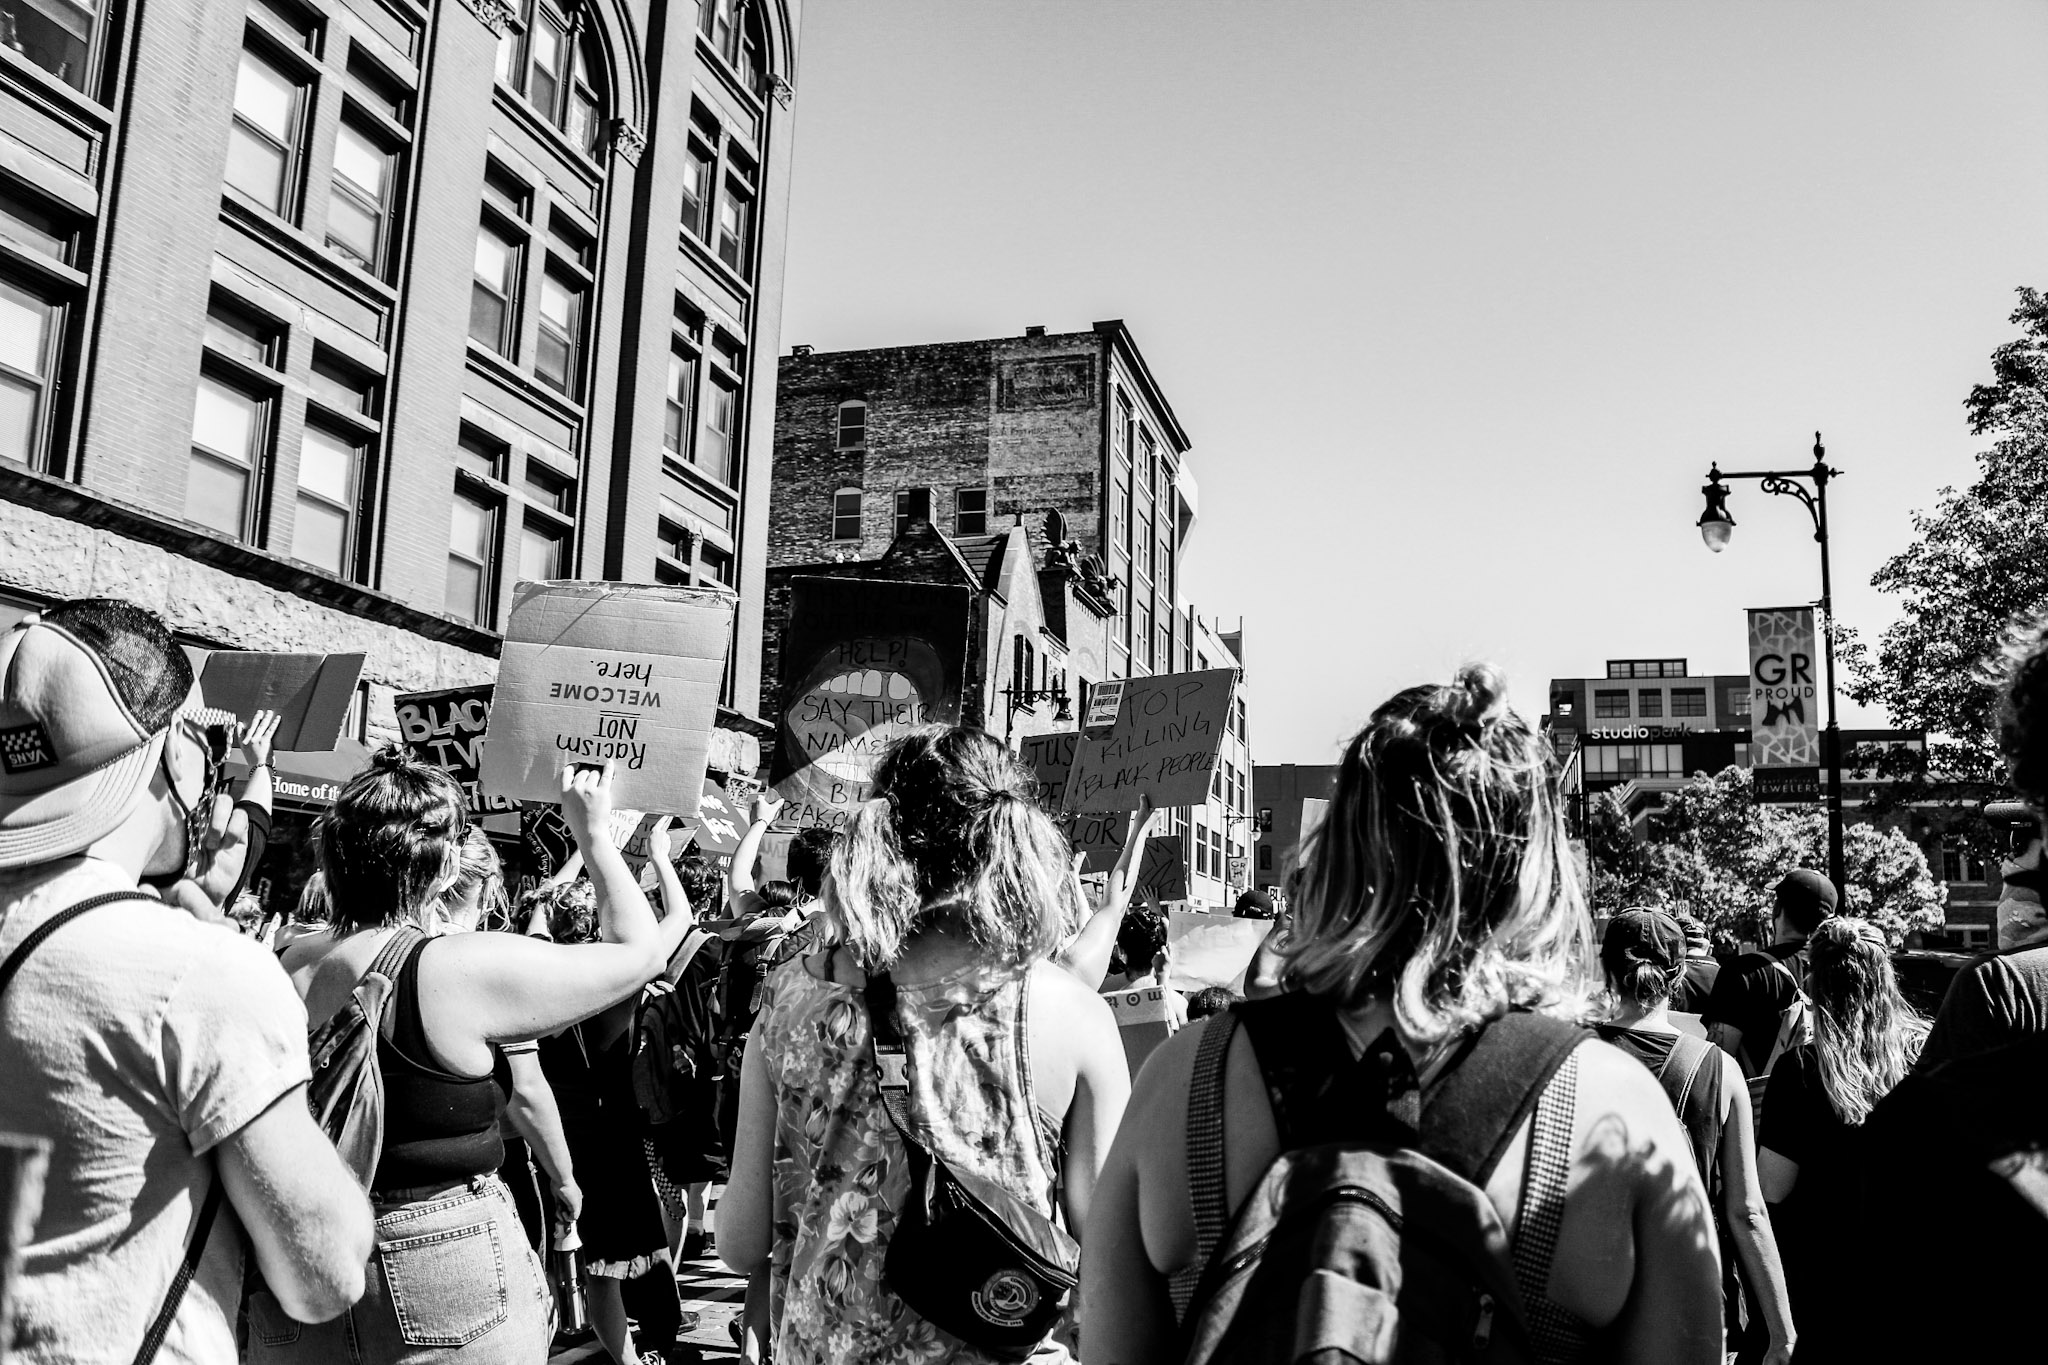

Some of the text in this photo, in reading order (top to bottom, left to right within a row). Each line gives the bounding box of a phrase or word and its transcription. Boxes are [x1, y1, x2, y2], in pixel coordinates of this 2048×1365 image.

[840, 640, 907, 667] HELP!
[590, 660, 652, 687] here.
[1755, 653, 1812, 686] GR
[550, 683, 661, 708] WELCOME
[1756, 687, 1814, 700] PROUD
[396, 699, 491, 742] BLAC
[802, 695, 933, 725] SAY THEIR
[592, 717, 637, 740] NOT
[1101, 711, 1210, 764] KILLING
[9, 749, 49, 767] VANS
[556, 734, 646, 770] Racism
[1084, 762, 1150, 801] BLACK
[1157, 750, 1218, 783] PEOPLE
[1755, 783, 1819, 794] JEWELERS
[311, 784, 330, 800] of
